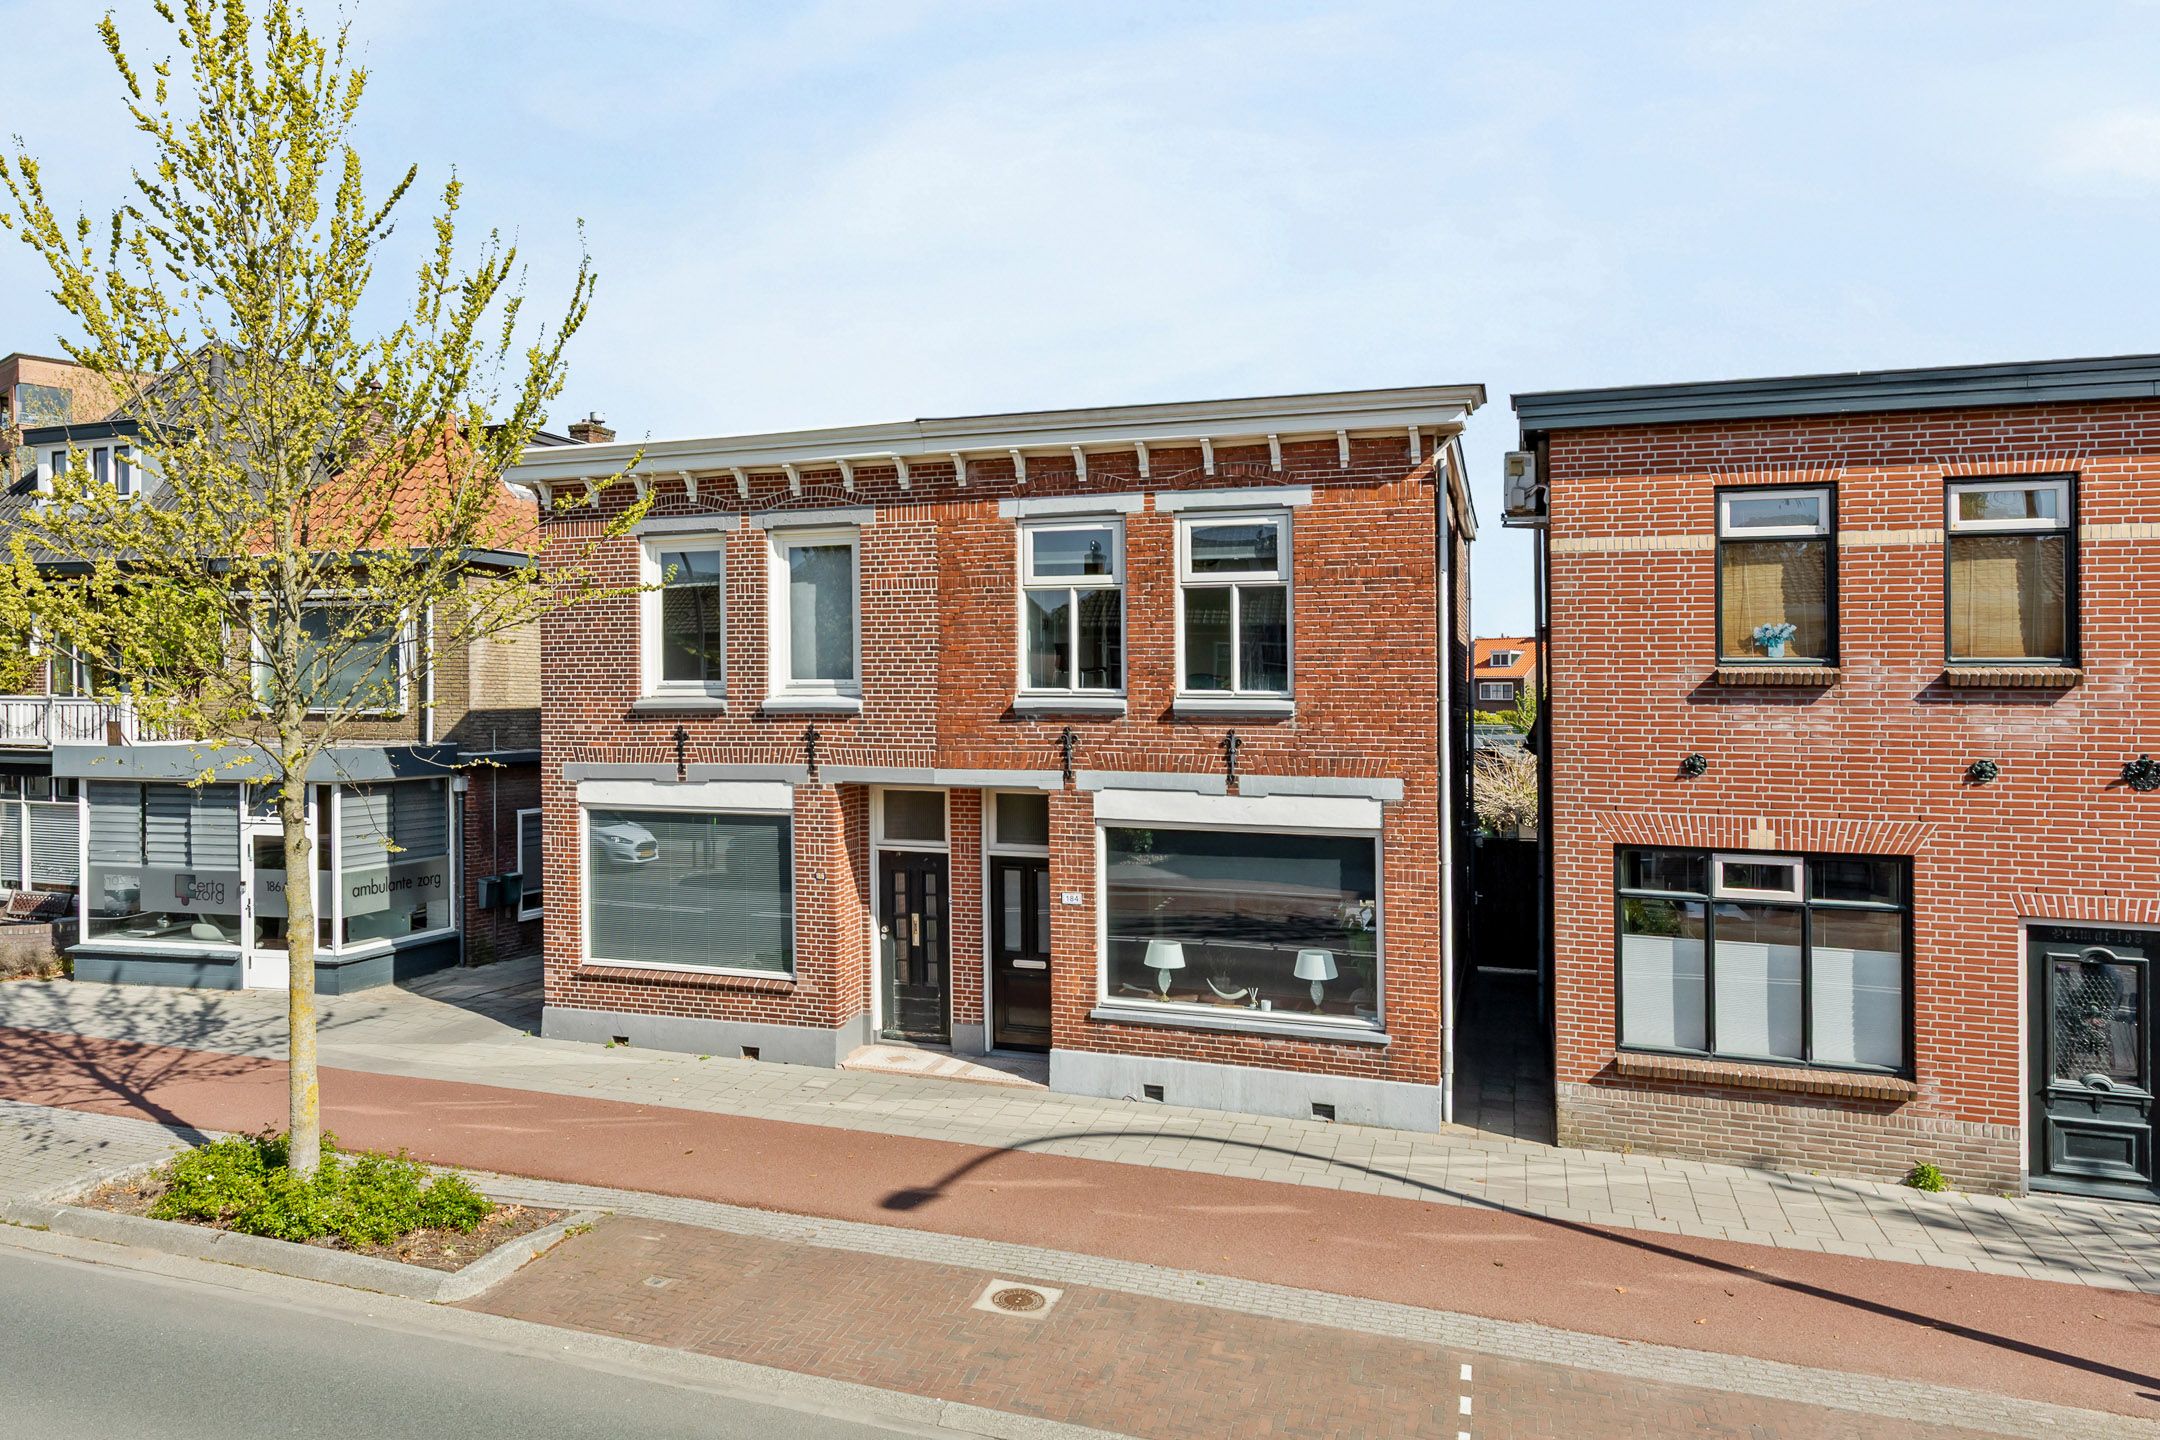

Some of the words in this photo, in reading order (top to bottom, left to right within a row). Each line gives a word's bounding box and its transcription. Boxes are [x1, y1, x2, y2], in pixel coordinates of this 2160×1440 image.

[352, 876, 412, 898] ambulante
[417, 874, 441, 889] zorg
[195, 890, 225, 905] zorg
